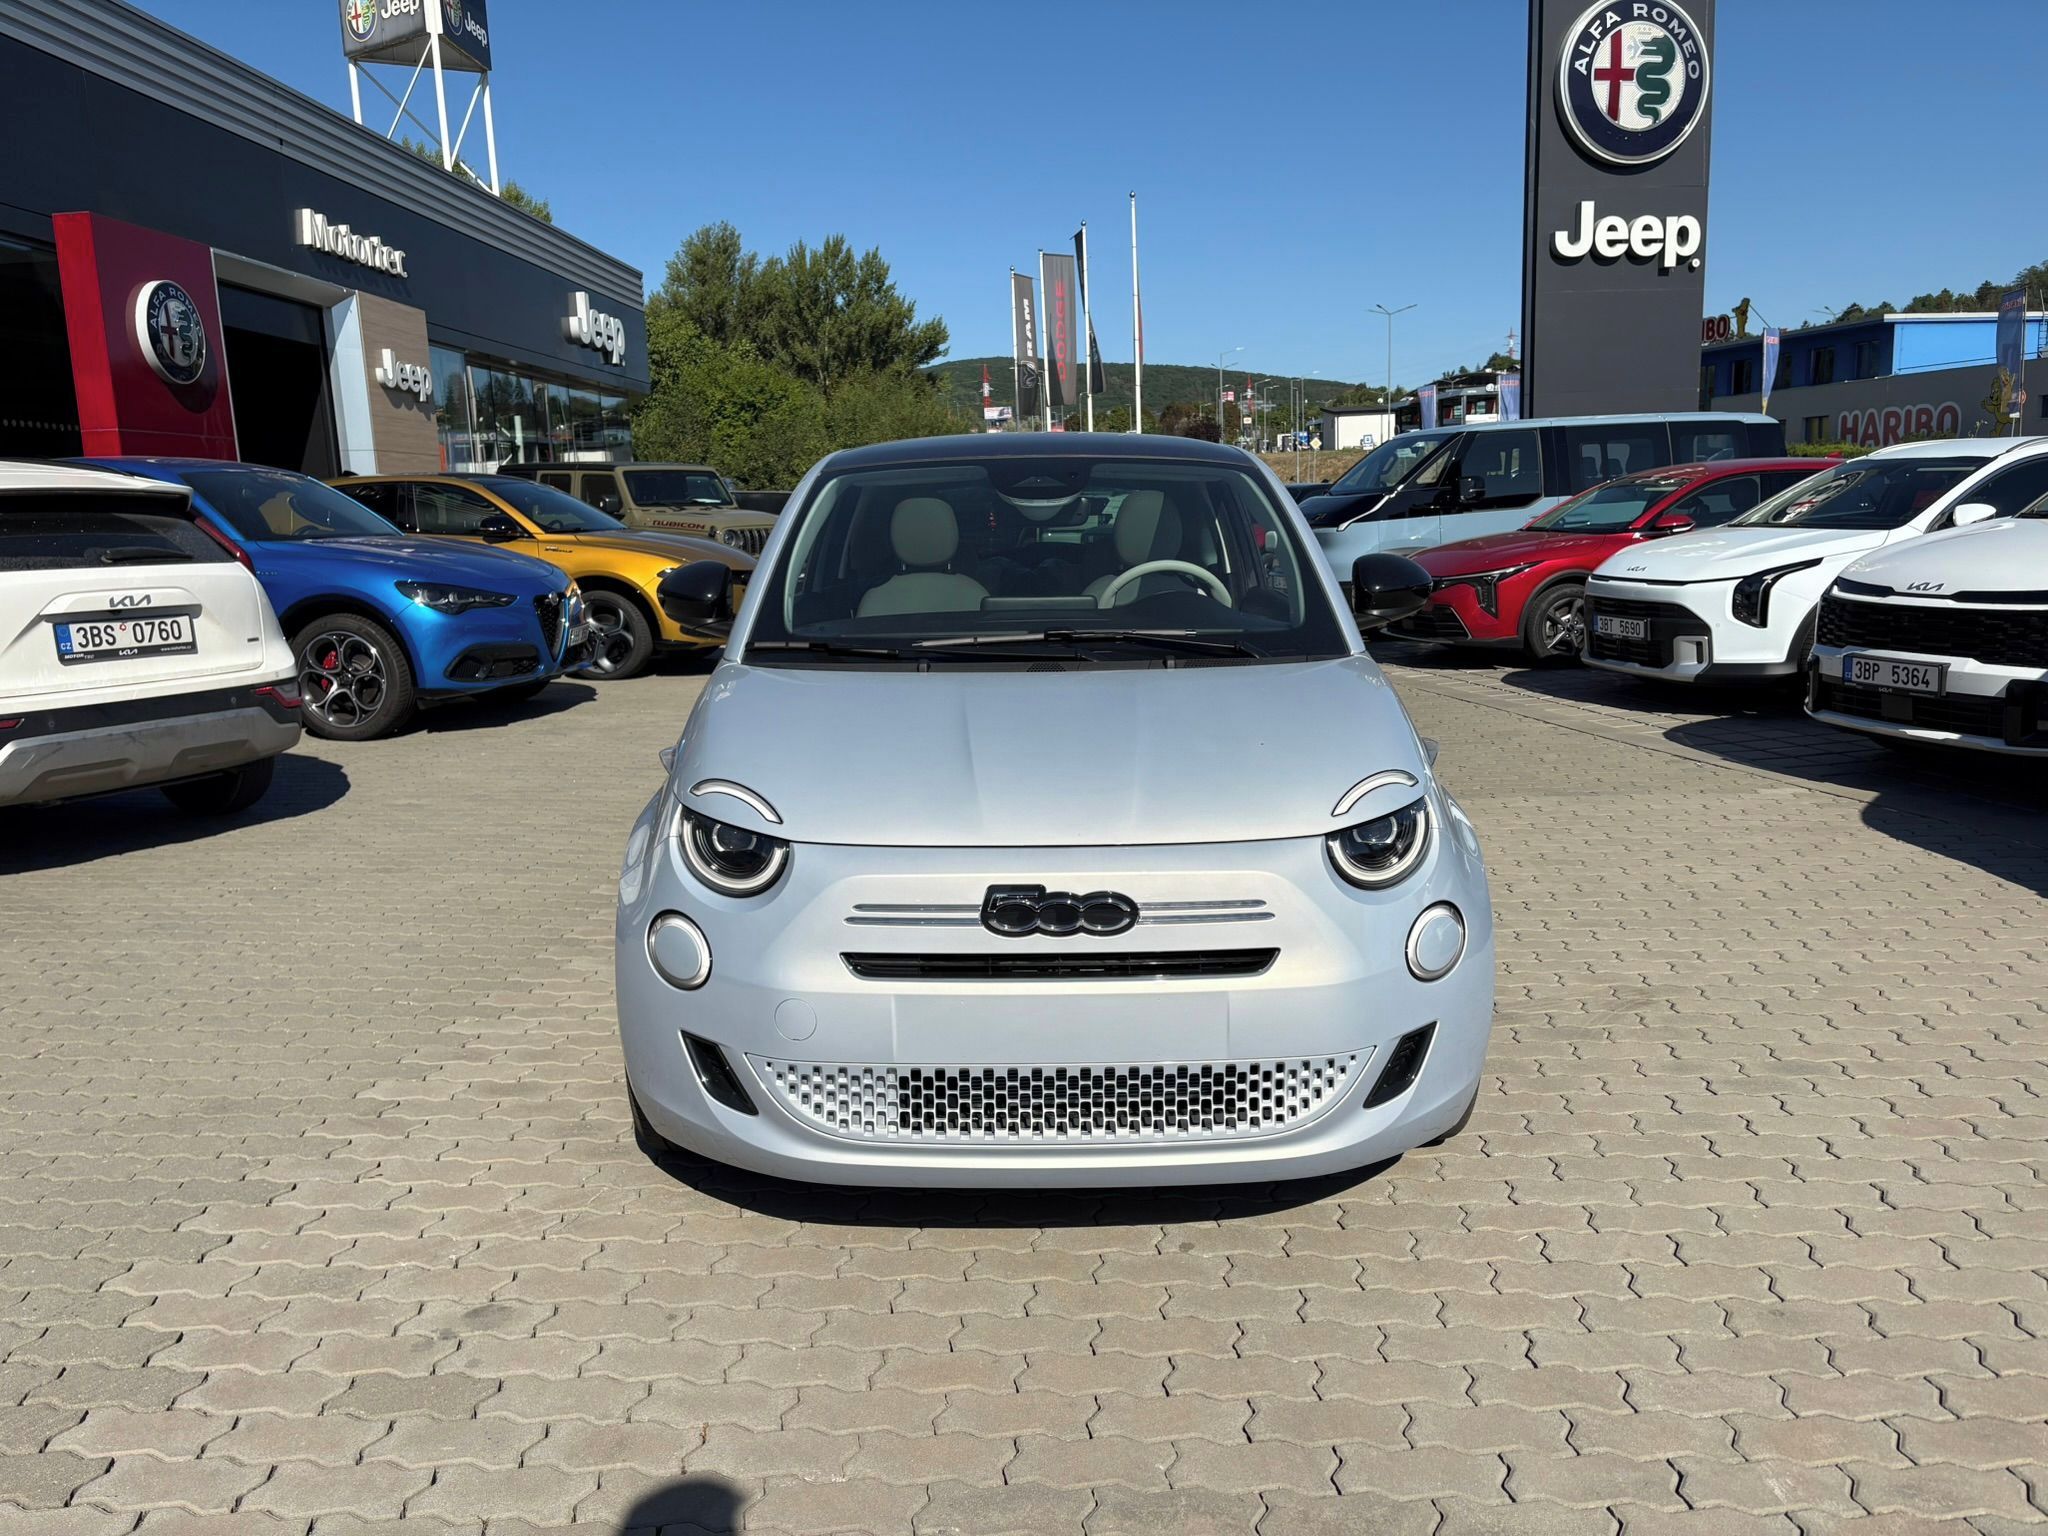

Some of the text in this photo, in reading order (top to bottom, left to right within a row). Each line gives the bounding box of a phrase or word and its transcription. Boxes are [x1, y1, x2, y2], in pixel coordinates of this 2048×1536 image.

[464, 12, 488, 47] Jeep
[1574, 3, 1700, 80] ALFA ROMEO
[297, 208, 408, 278] Motortec
[1554, 200, 1701, 268] Jeep
[565, 291, 626, 367] Jeep
[1023, 298, 1034, 357] RAM
[1055, 279, 1068, 384] DODGE
[375, 348, 433, 402] Jeep
[1838, 401, 1961, 447] HARIBO
[652, 519, 706, 530] RUBICON
[60, 619, 182, 650] CZ 3BS 0760
[1600, 617, 1641, 636] 3BT 5690
[1855, 661, 1880, 681] 3BP
[1891, 665, 1930, 688] 5364
[981, 884, 1140, 937] 500
